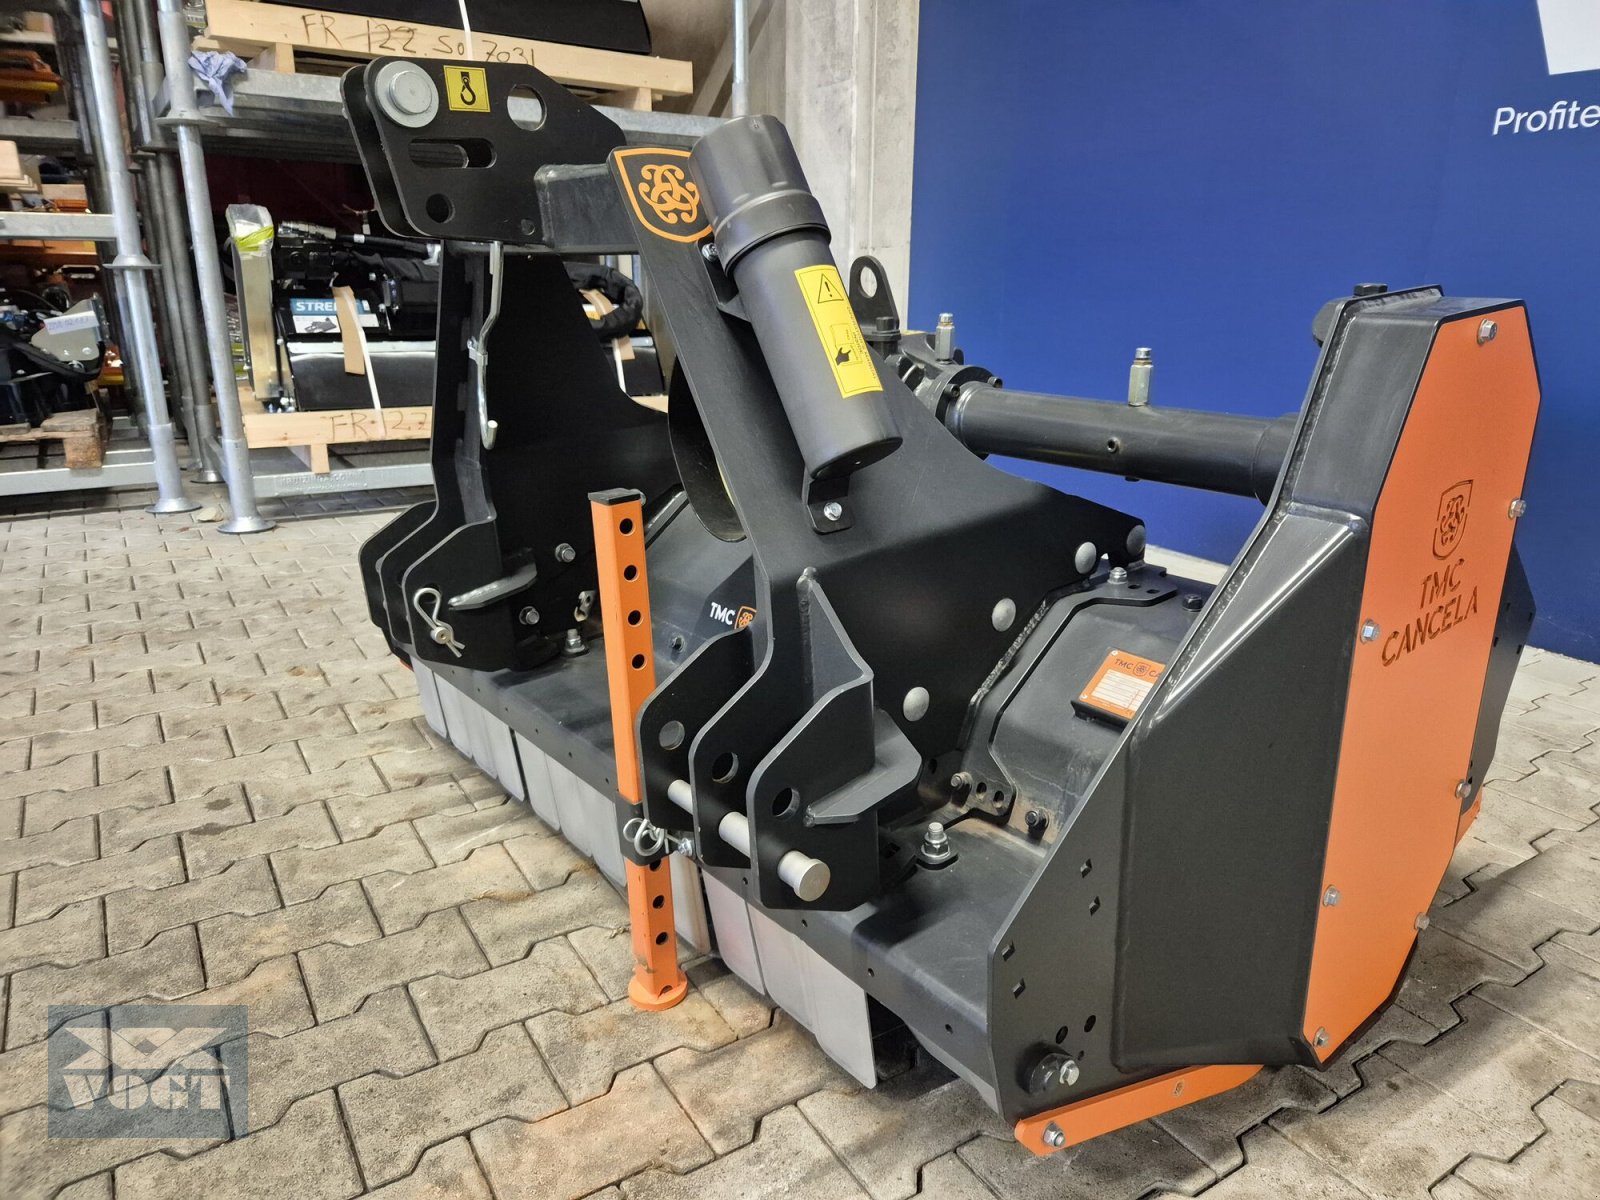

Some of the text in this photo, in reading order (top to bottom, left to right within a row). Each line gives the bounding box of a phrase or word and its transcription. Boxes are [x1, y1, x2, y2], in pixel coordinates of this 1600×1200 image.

[1492, 100, 1600, 136] Profite
[1419, 557, 1464, 609] TMC
[709, 601, 735, 626] TMC
[1381, 585, 1478, 667] CANCELA
[1114, 658, 1133, 670] TMC
